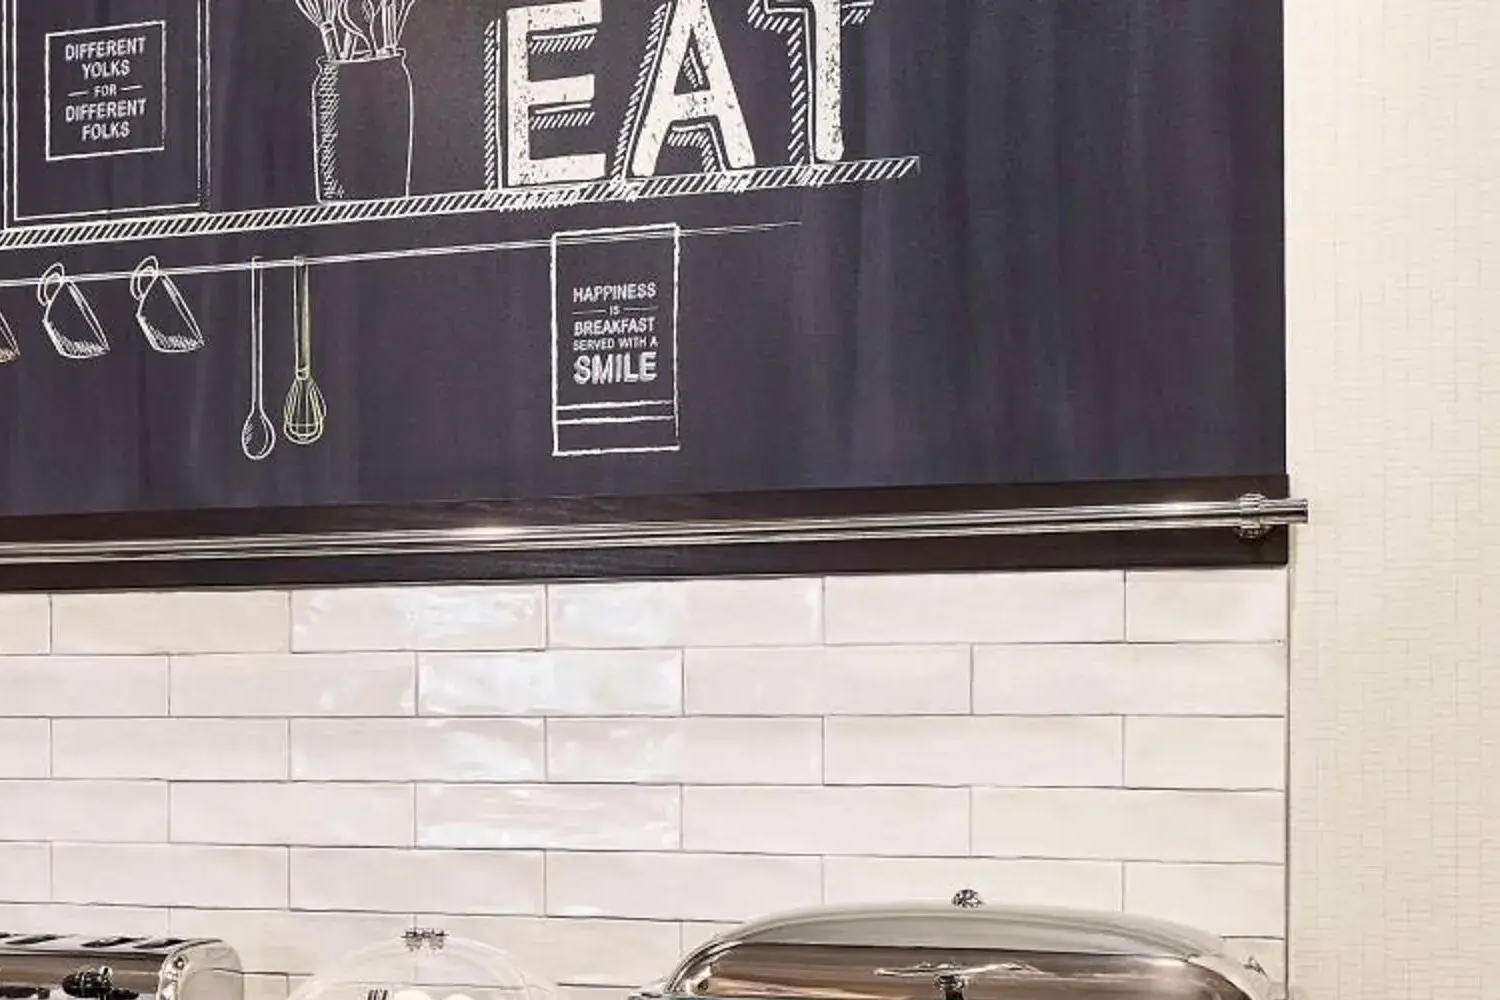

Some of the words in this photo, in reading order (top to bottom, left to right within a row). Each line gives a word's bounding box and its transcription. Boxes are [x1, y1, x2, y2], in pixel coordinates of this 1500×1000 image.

[65, 37, 147, 61] DIFFERENT
[81, 59, 131, 80] YOLKS
[94, 84, 117, 97] FOR
[503, 0, 848, 187] EAT
[65, 98, 147, 123] DIFFERENT
[81, 121, 131, 142] FOLKS
[572, 282, 657, 303] HAPPINESS
[609, 305, 621, 316] IS
[573, 317, 655, 337] BREAKFAST
[573, 338, 615, 351] SERVED
[618, 336, 647, 349] WITH
[650, 336, 658, 347] A
[573, 351, 658, 385] SMILE
